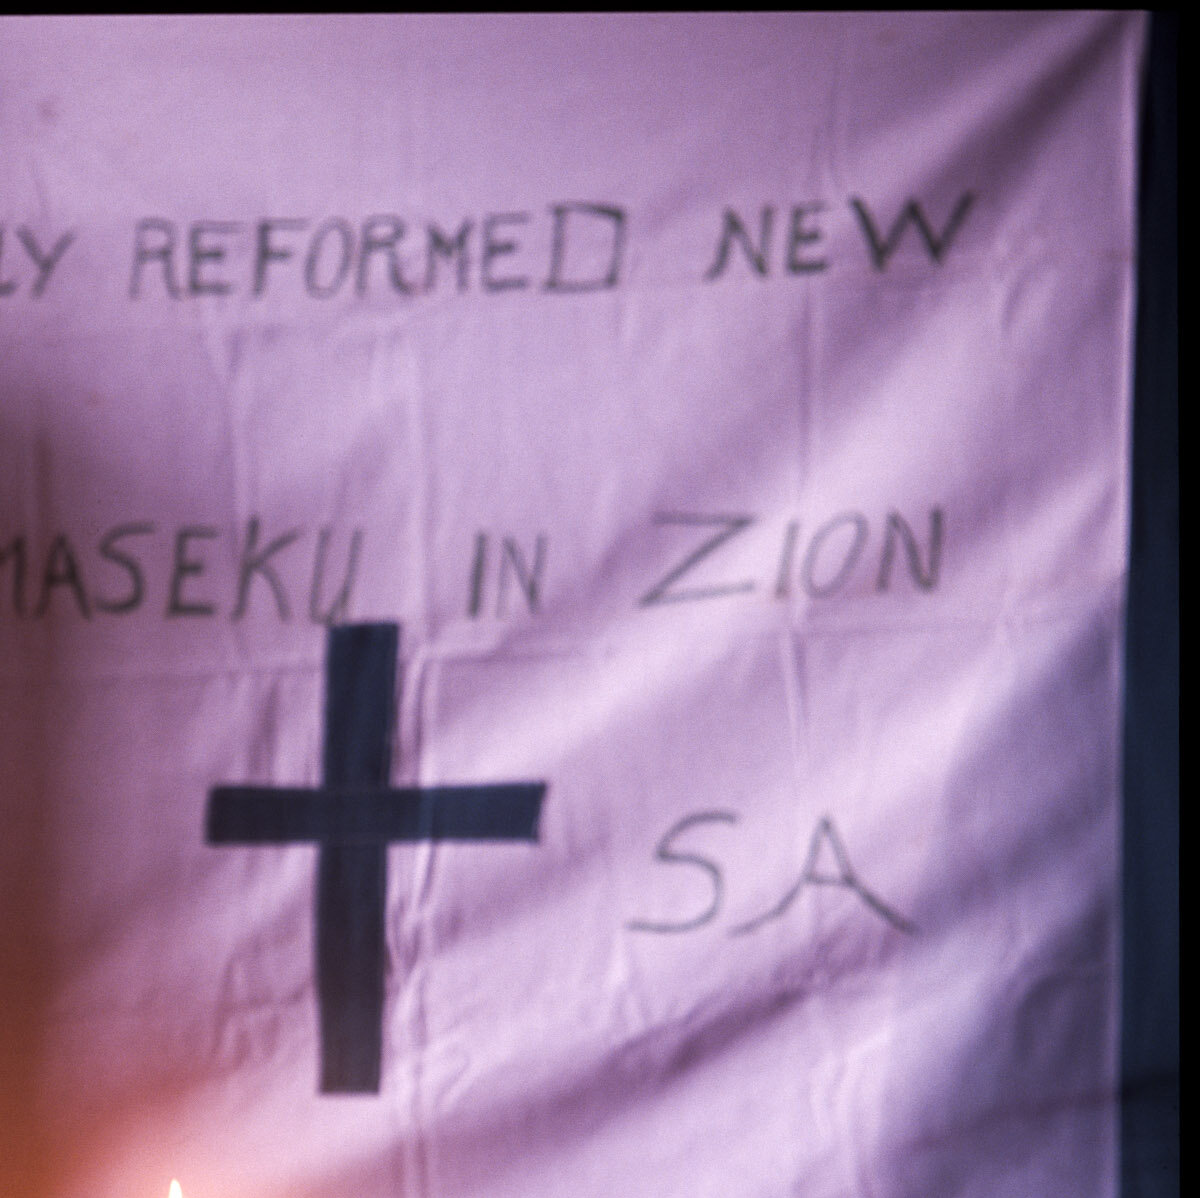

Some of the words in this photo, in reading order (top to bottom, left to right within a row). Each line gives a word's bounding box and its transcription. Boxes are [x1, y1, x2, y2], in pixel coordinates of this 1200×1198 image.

[128, 202, 627, 299] REFORMED
[704, 192, 976, 281] NEW
[467, 531, 547, 619] IN
[637, 505, 944, 608] ZION
[624, 811, 921, 938] SA
